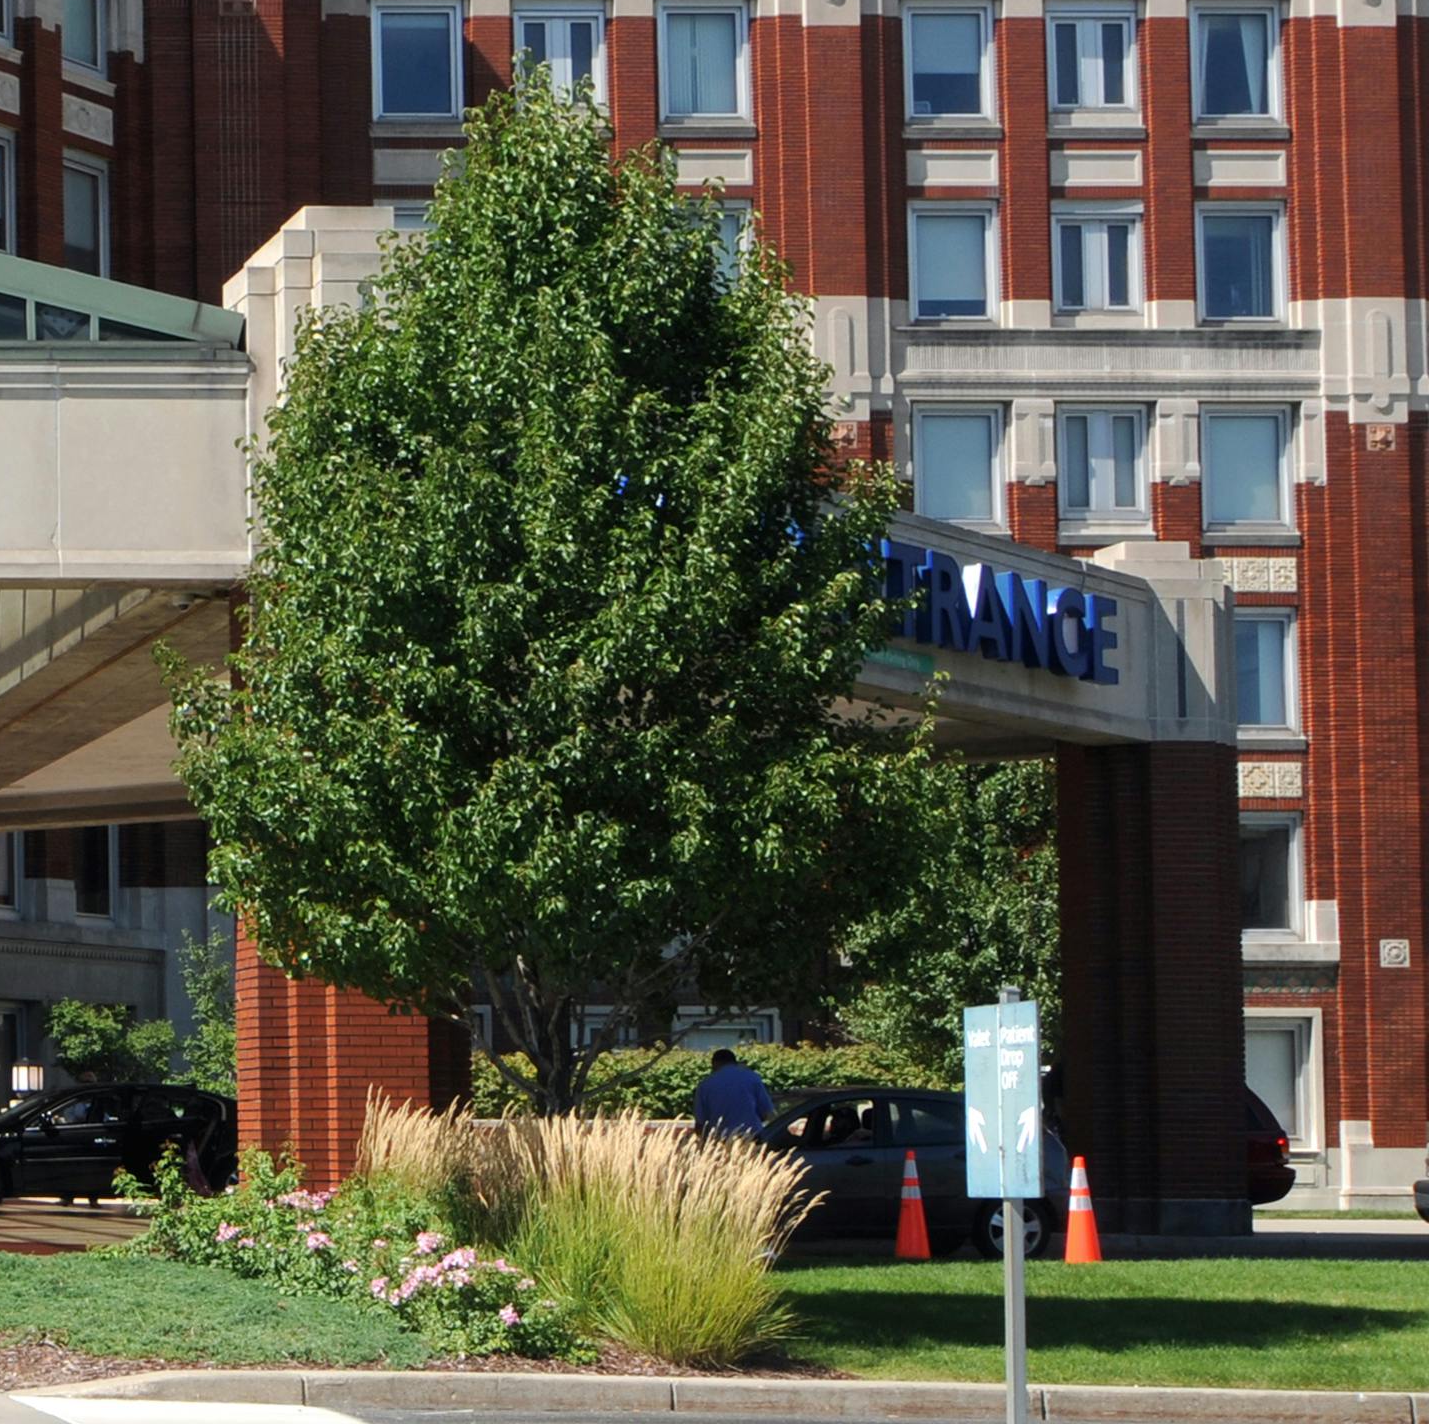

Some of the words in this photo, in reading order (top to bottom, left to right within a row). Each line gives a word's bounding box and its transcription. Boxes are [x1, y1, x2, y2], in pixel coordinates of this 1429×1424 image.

[966, 1028, 991, 1049] Valet
[1000, 1024, 1035, 1045] Patient
[1001, 1048, 1024, 1068] Drop
[1002, 1070, 1019, 1089] Off
